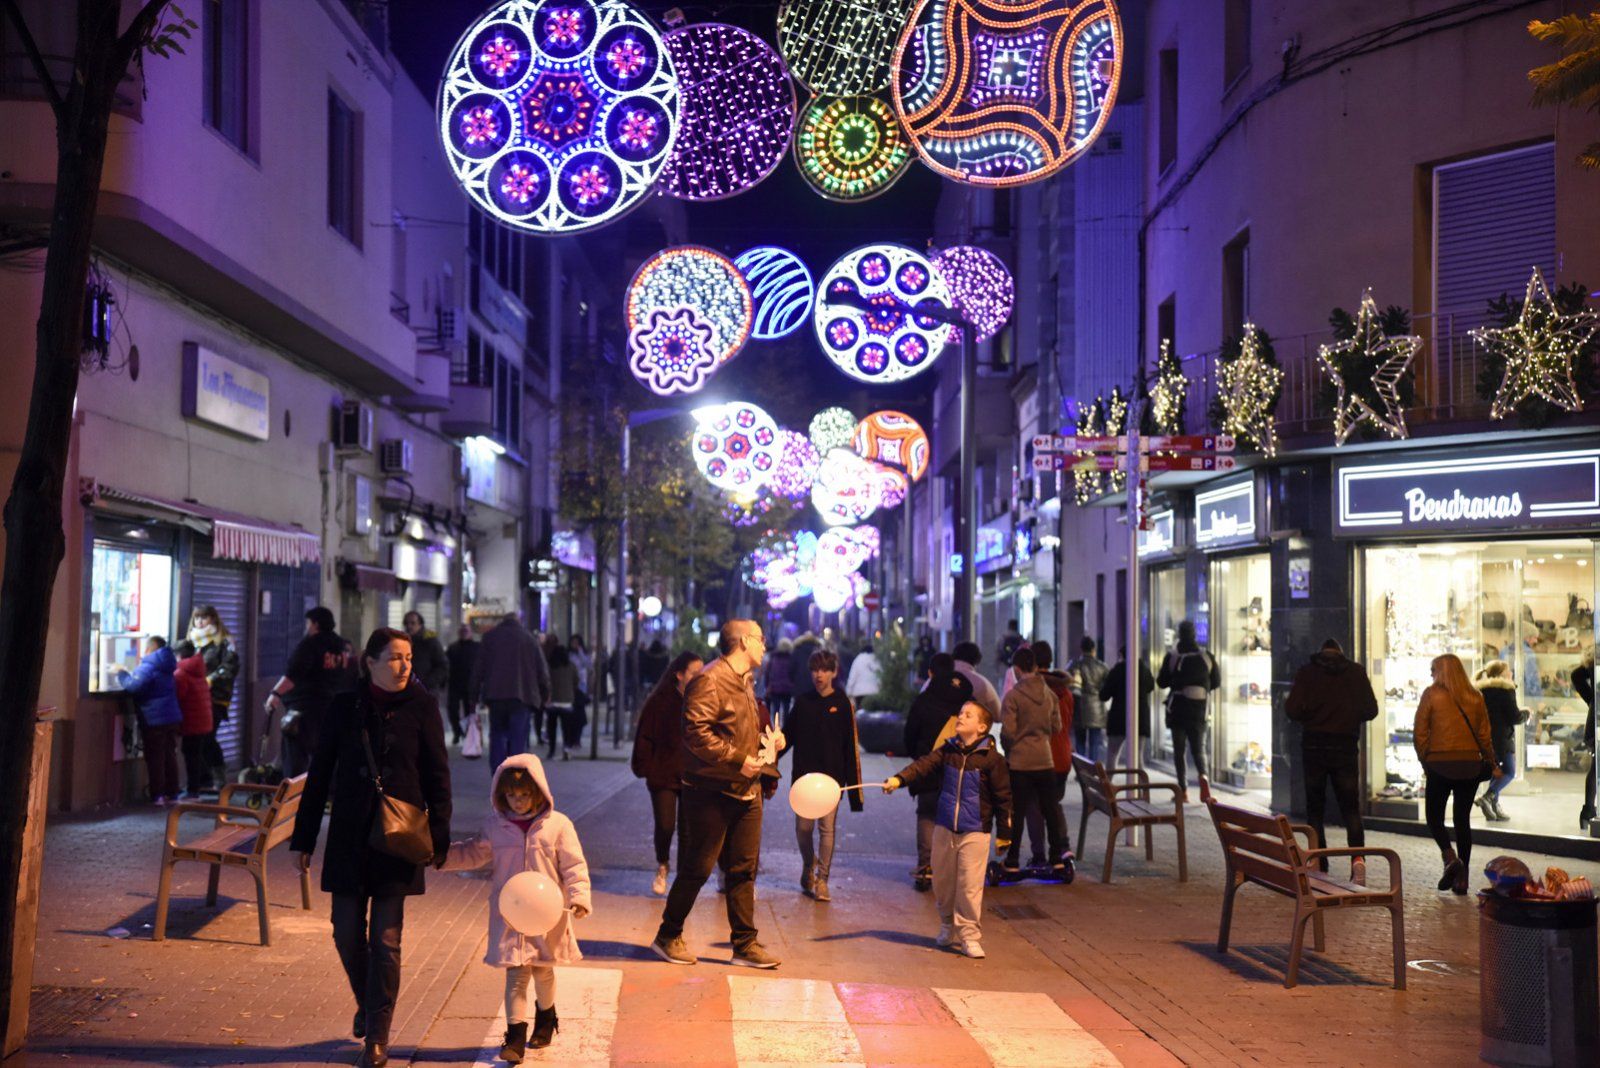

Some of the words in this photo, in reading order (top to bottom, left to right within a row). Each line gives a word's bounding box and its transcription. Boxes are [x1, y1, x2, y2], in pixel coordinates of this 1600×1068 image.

[1055, 438, 1062, 448] P
[1204, 438, 1213, 449] P
[1055, 458, 1063, 467] P
[1204, 458, 1213, 468] P
[1404, 487, 1523, 522] Bendranas
